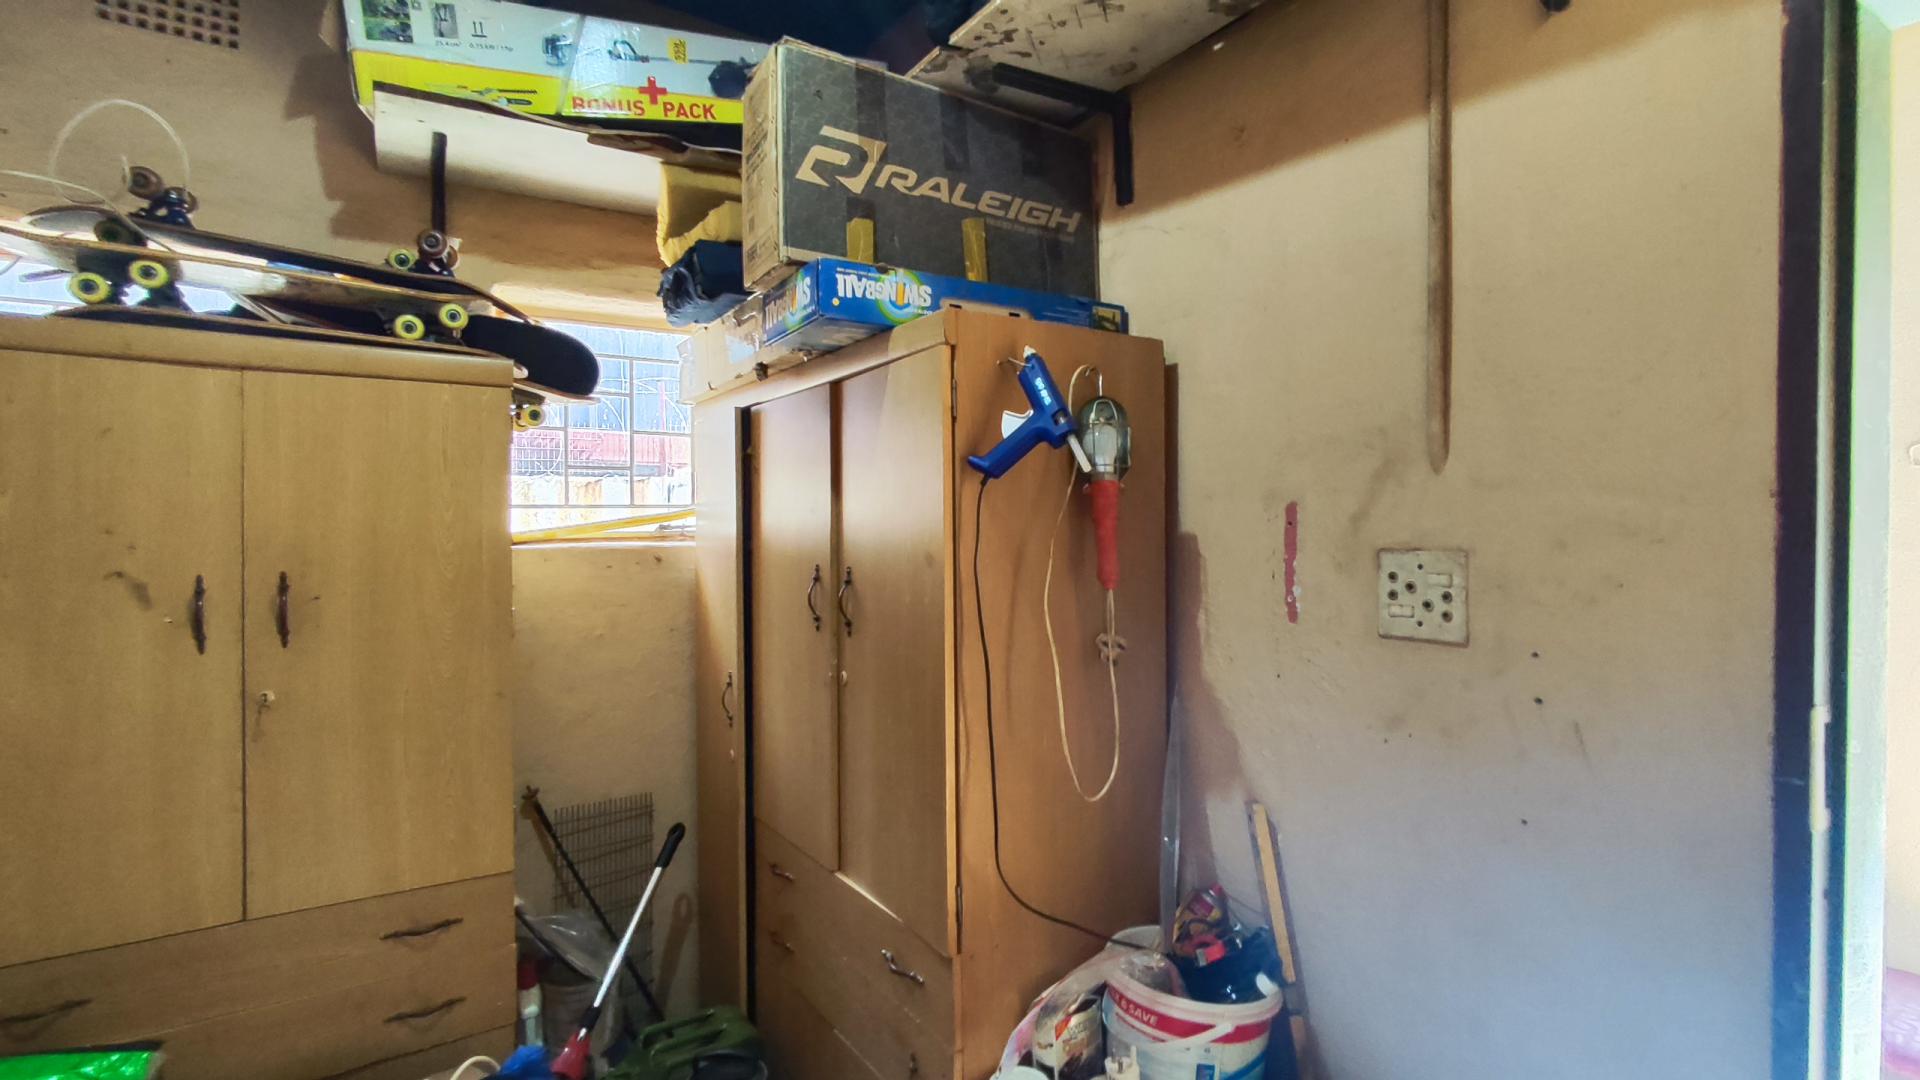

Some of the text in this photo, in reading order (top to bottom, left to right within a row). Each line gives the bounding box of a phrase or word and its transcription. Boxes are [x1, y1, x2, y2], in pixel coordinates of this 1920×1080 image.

[572, 96, 717, 120] BONUS PACK
[875, 164, 1081, 233] RALEIGH
[835, 273, 932, 307] SWINGBALL
[1128, 1004, 1158, 1025] SAVE
